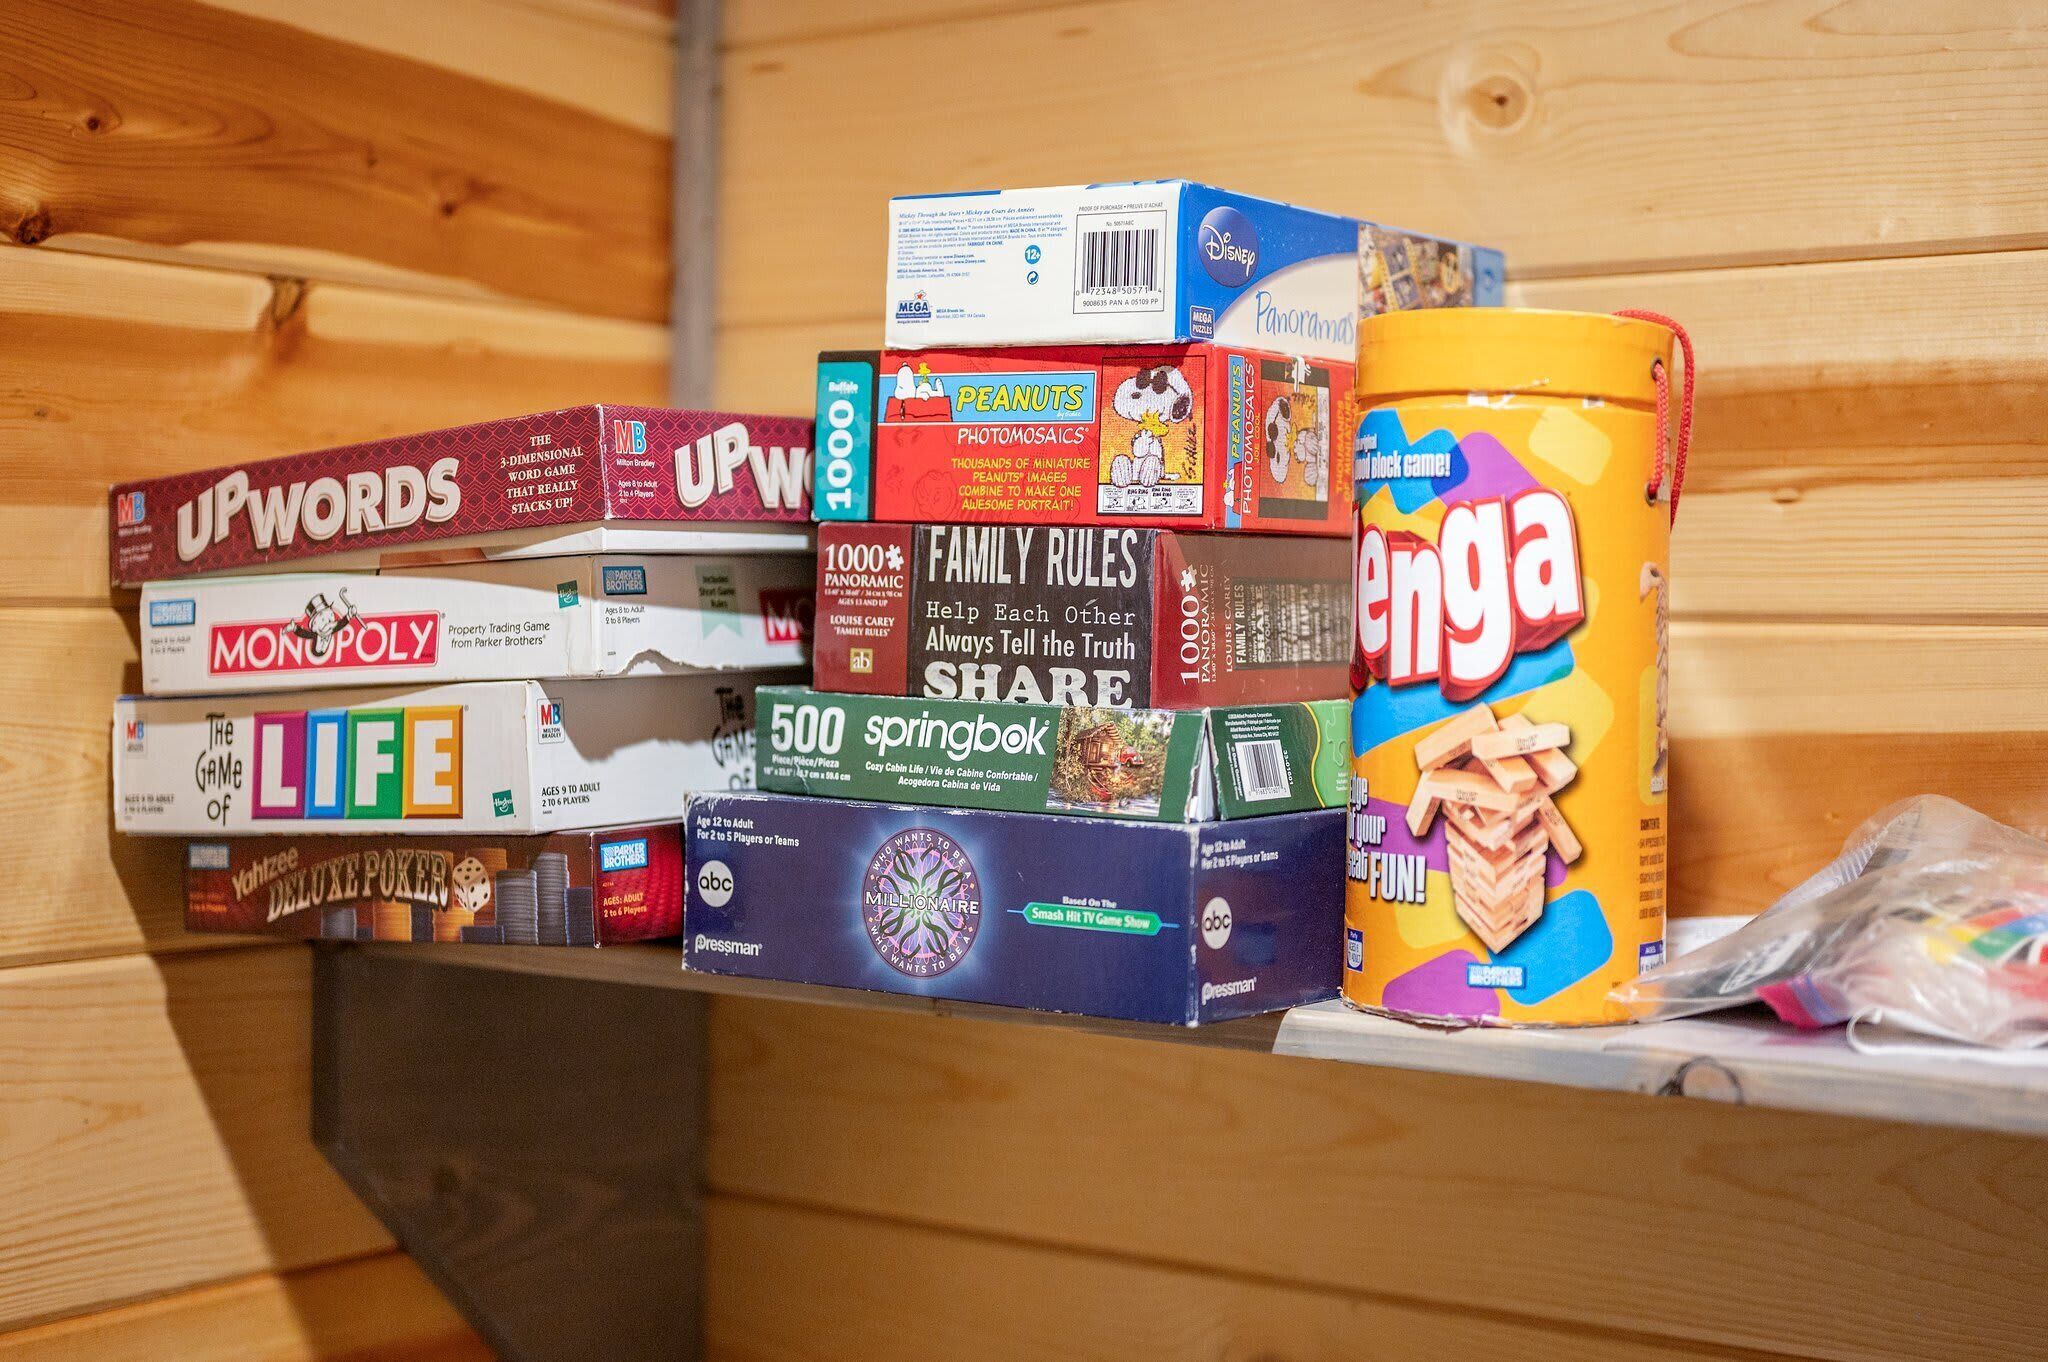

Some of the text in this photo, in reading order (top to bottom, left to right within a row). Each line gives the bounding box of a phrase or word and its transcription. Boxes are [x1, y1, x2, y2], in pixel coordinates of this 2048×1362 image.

[1025, 249, 1041, 261] 12+
[1090, 286, 1148, 296] 72348 50571
[898, 302, 929, 312] MEGA
[1131, 298, 1149, 306] 05109
[1193, 312, 1212, 324] MEGA
[1255, 290, 1355, 345] Panoramas
[1192, 324, 1212, 335] PUZZLES
[956, 384, 1084, 412] PEANUTS
[1232, 364, 1242, 459] PEANUTS
[530, 434, 552, 447] THE
[613, 419, 647, 455] MB
[957, 426, 1085, 445] PHOTOMOSAICS
[1242, 362, 1255, 514] PHOTOMOSAICS
[500, 446, 584, 469] 3-DIMENSIONAL
[616, 458, 656, 468] Milton Bradley
[826, 399, 855, 511] 1000
[951, 458, 1091, 470] THOUSANDS OF MINIATURE
[508, 464, 576, 482] WORD GAME
[972, 472, 1068, 483] PEANUTS IMAGES
[506, 480, 579, 499] THAT REALLY
[958, 485, 1082, 497] COMBINE TO MAKE ONE
[118, 491, 146, 528] MB
[176, 456, 461, 562] UPWORDS
[511, 497, 573, 514] STACKS UP!
[961, 499, 1074, 511] AWESOME PORTRAIT!
[825, 544, 884, 572] 1000
[928, 526, 1138, 588] FAMILY RULES
[616, 570, 642, 580] PARKER
[824, 573, 904, 589] PANORAMIC
[606, 580, 643, 591] BROTHERS
[1352, 488, 1583, 690] enga
[830, 614, 895, 627] LOUISE CAREY
[926, 601, 1136, 626] Help Each Other
[448, 621, 550, 636] Property Trading Game
[1200, 564, 1210, 684] PANORAMIC
[1224, 575, 1233, 673] LOUISE CAREY
[1234, 584, 1246, 664] FAMILY RULES
[1256, 585, 1265, 664] SHARE
[213, 620, 434, 670] MONOPOLY
[451, 635, 544, 649] from Parker Brothers
[925, 624, 1136, 660] Always Tell the Truth
[1180, 595, 1200, 686] 1000
[852, 651, 870, 670] ab
[923, 661, 1132, 709] SHARE
[541, 703, 561, 726] MB
[771, 704, 846, 755] 500
[864, 710, 1050, 762] springbok
[259, 719, 454, 808] LIFE
[865, 761, 1034, 782] Cozy Cabin Life Vie de Cabine Confortable
[542, 782, 600, 796] AGES 9 TO ADULT
[898, 776, 1000, 792] Acogedora Cabina de Vida
[542, 795, 590, 808] 2 TO 6 PLAYERS
[696, 815, 754, 830] Age 12 to Adult
[696, 828, 800, 847] For 2 to 5 Players or Teams
[614, 842, 645, 856] PARKER
[873, 832, 972, 880] WHO WANTS TO BE A
[604, 854, 646, 869] BROTHERS
[232, 846, 299, 902] Yahtzee
[700, 872, 732, 892] abc
[1370, 851, 1426, 904] FUN!
[266, 849, 448, 924] DELUXE POKER
[603, 892, 644, 906] AGES: ADULT
[865, 891, 979, 915] MILLIONAIRE
[1062, 896, 1117, 909] Based On The
[1032, 907, 1150, 930] Smash Hit TV Game Show
[1204, 910, 1231, 934] abc
